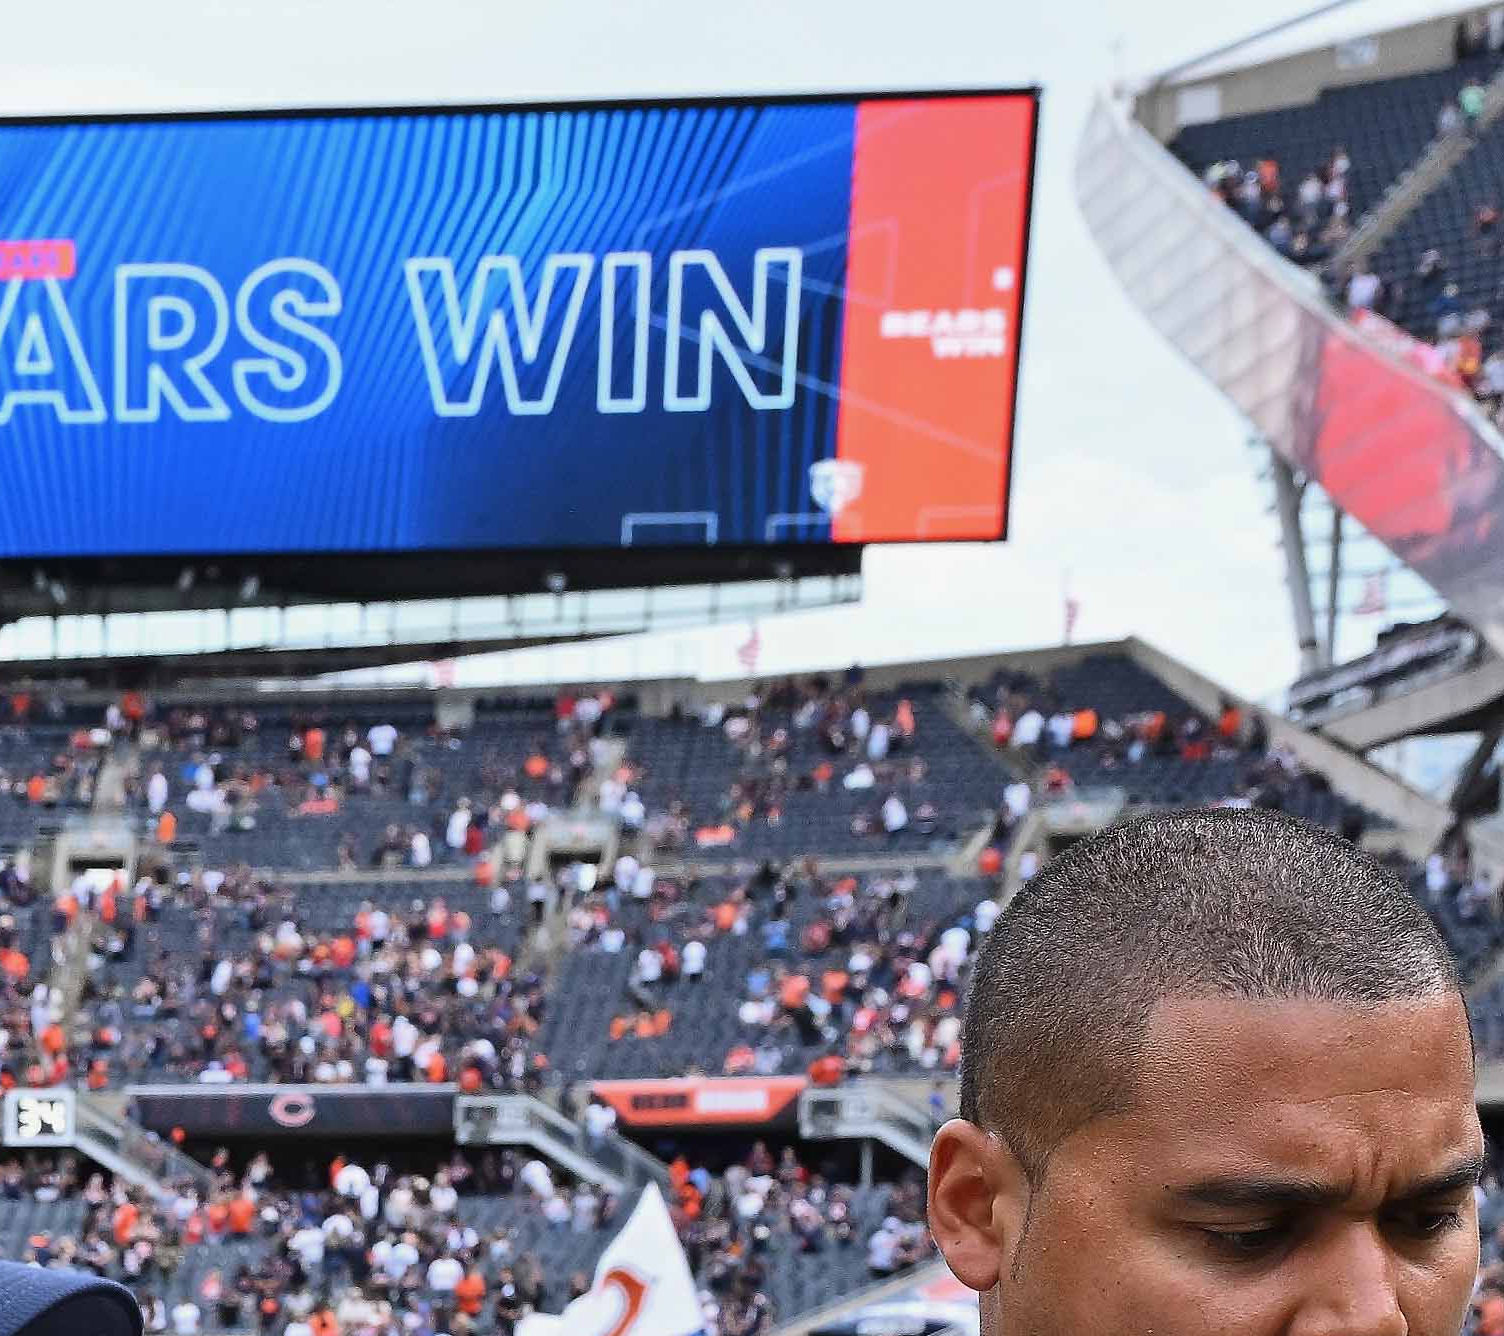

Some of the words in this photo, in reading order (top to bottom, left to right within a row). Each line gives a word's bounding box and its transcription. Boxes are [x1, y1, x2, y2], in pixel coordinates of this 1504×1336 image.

[404, 247, 803, 419] WIN
[879, 309, 1006, 338] BEARS
[16, 1097, 67, 1138] 34
